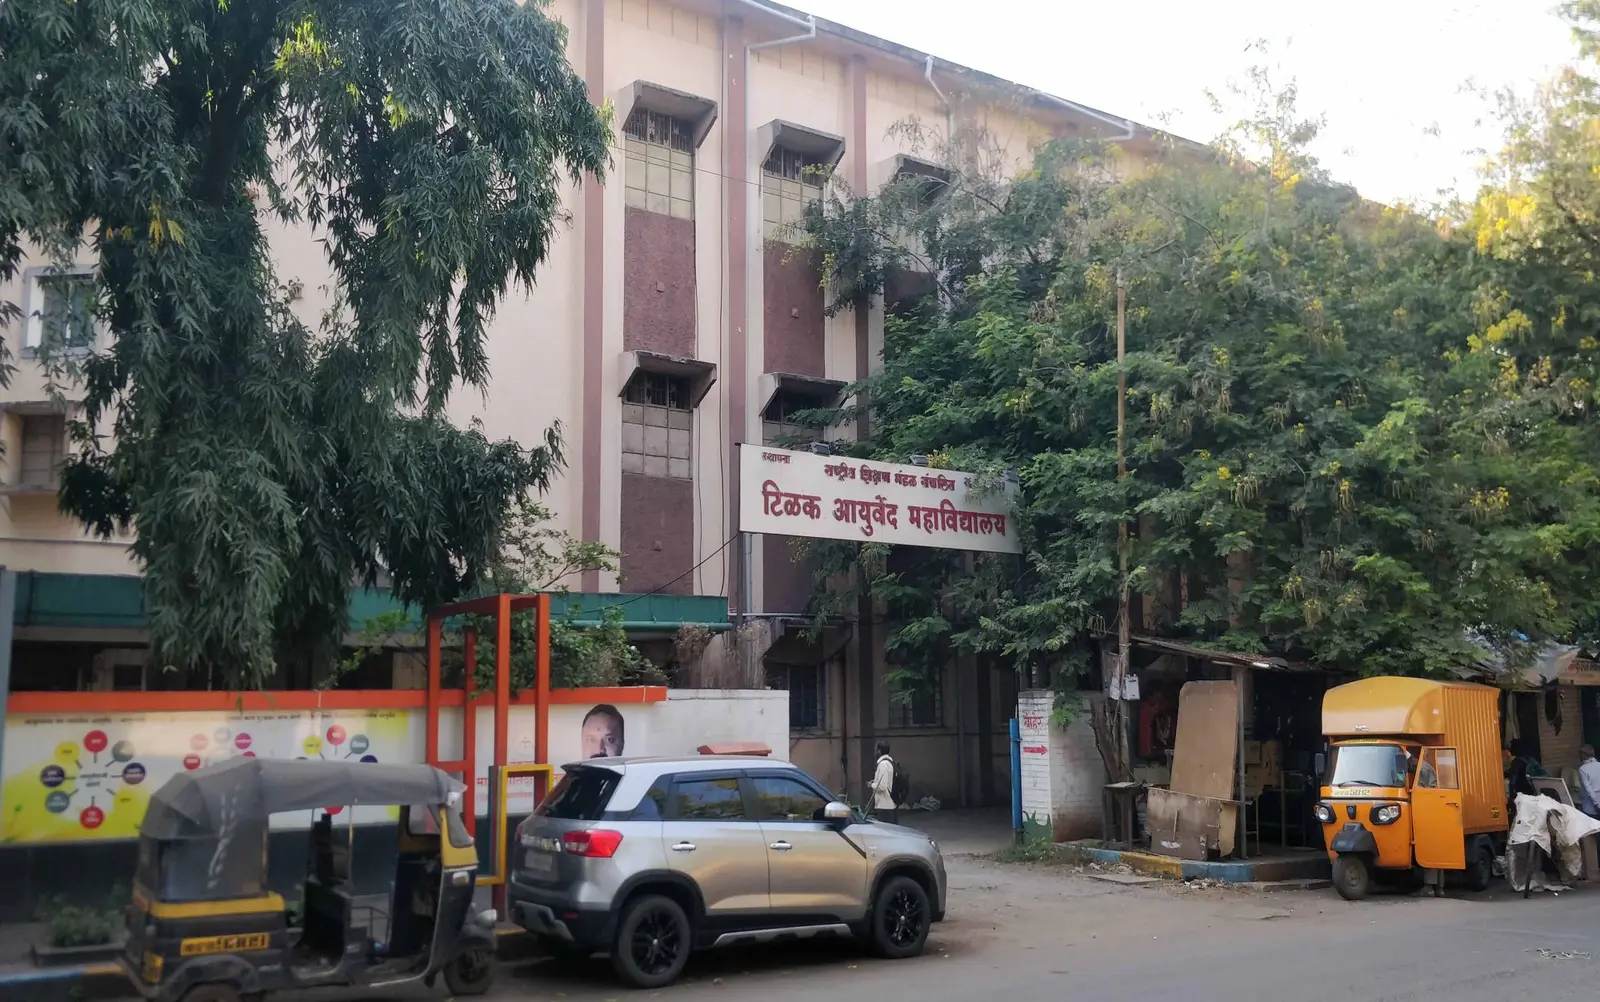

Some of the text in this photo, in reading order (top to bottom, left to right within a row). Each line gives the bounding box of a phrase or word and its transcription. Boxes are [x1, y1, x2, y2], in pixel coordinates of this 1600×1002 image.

[860, 464, 891, 485] शिक्षण
[762, 479, 1006, 536] टिळक आयुर्वेद महाविद्यालय
